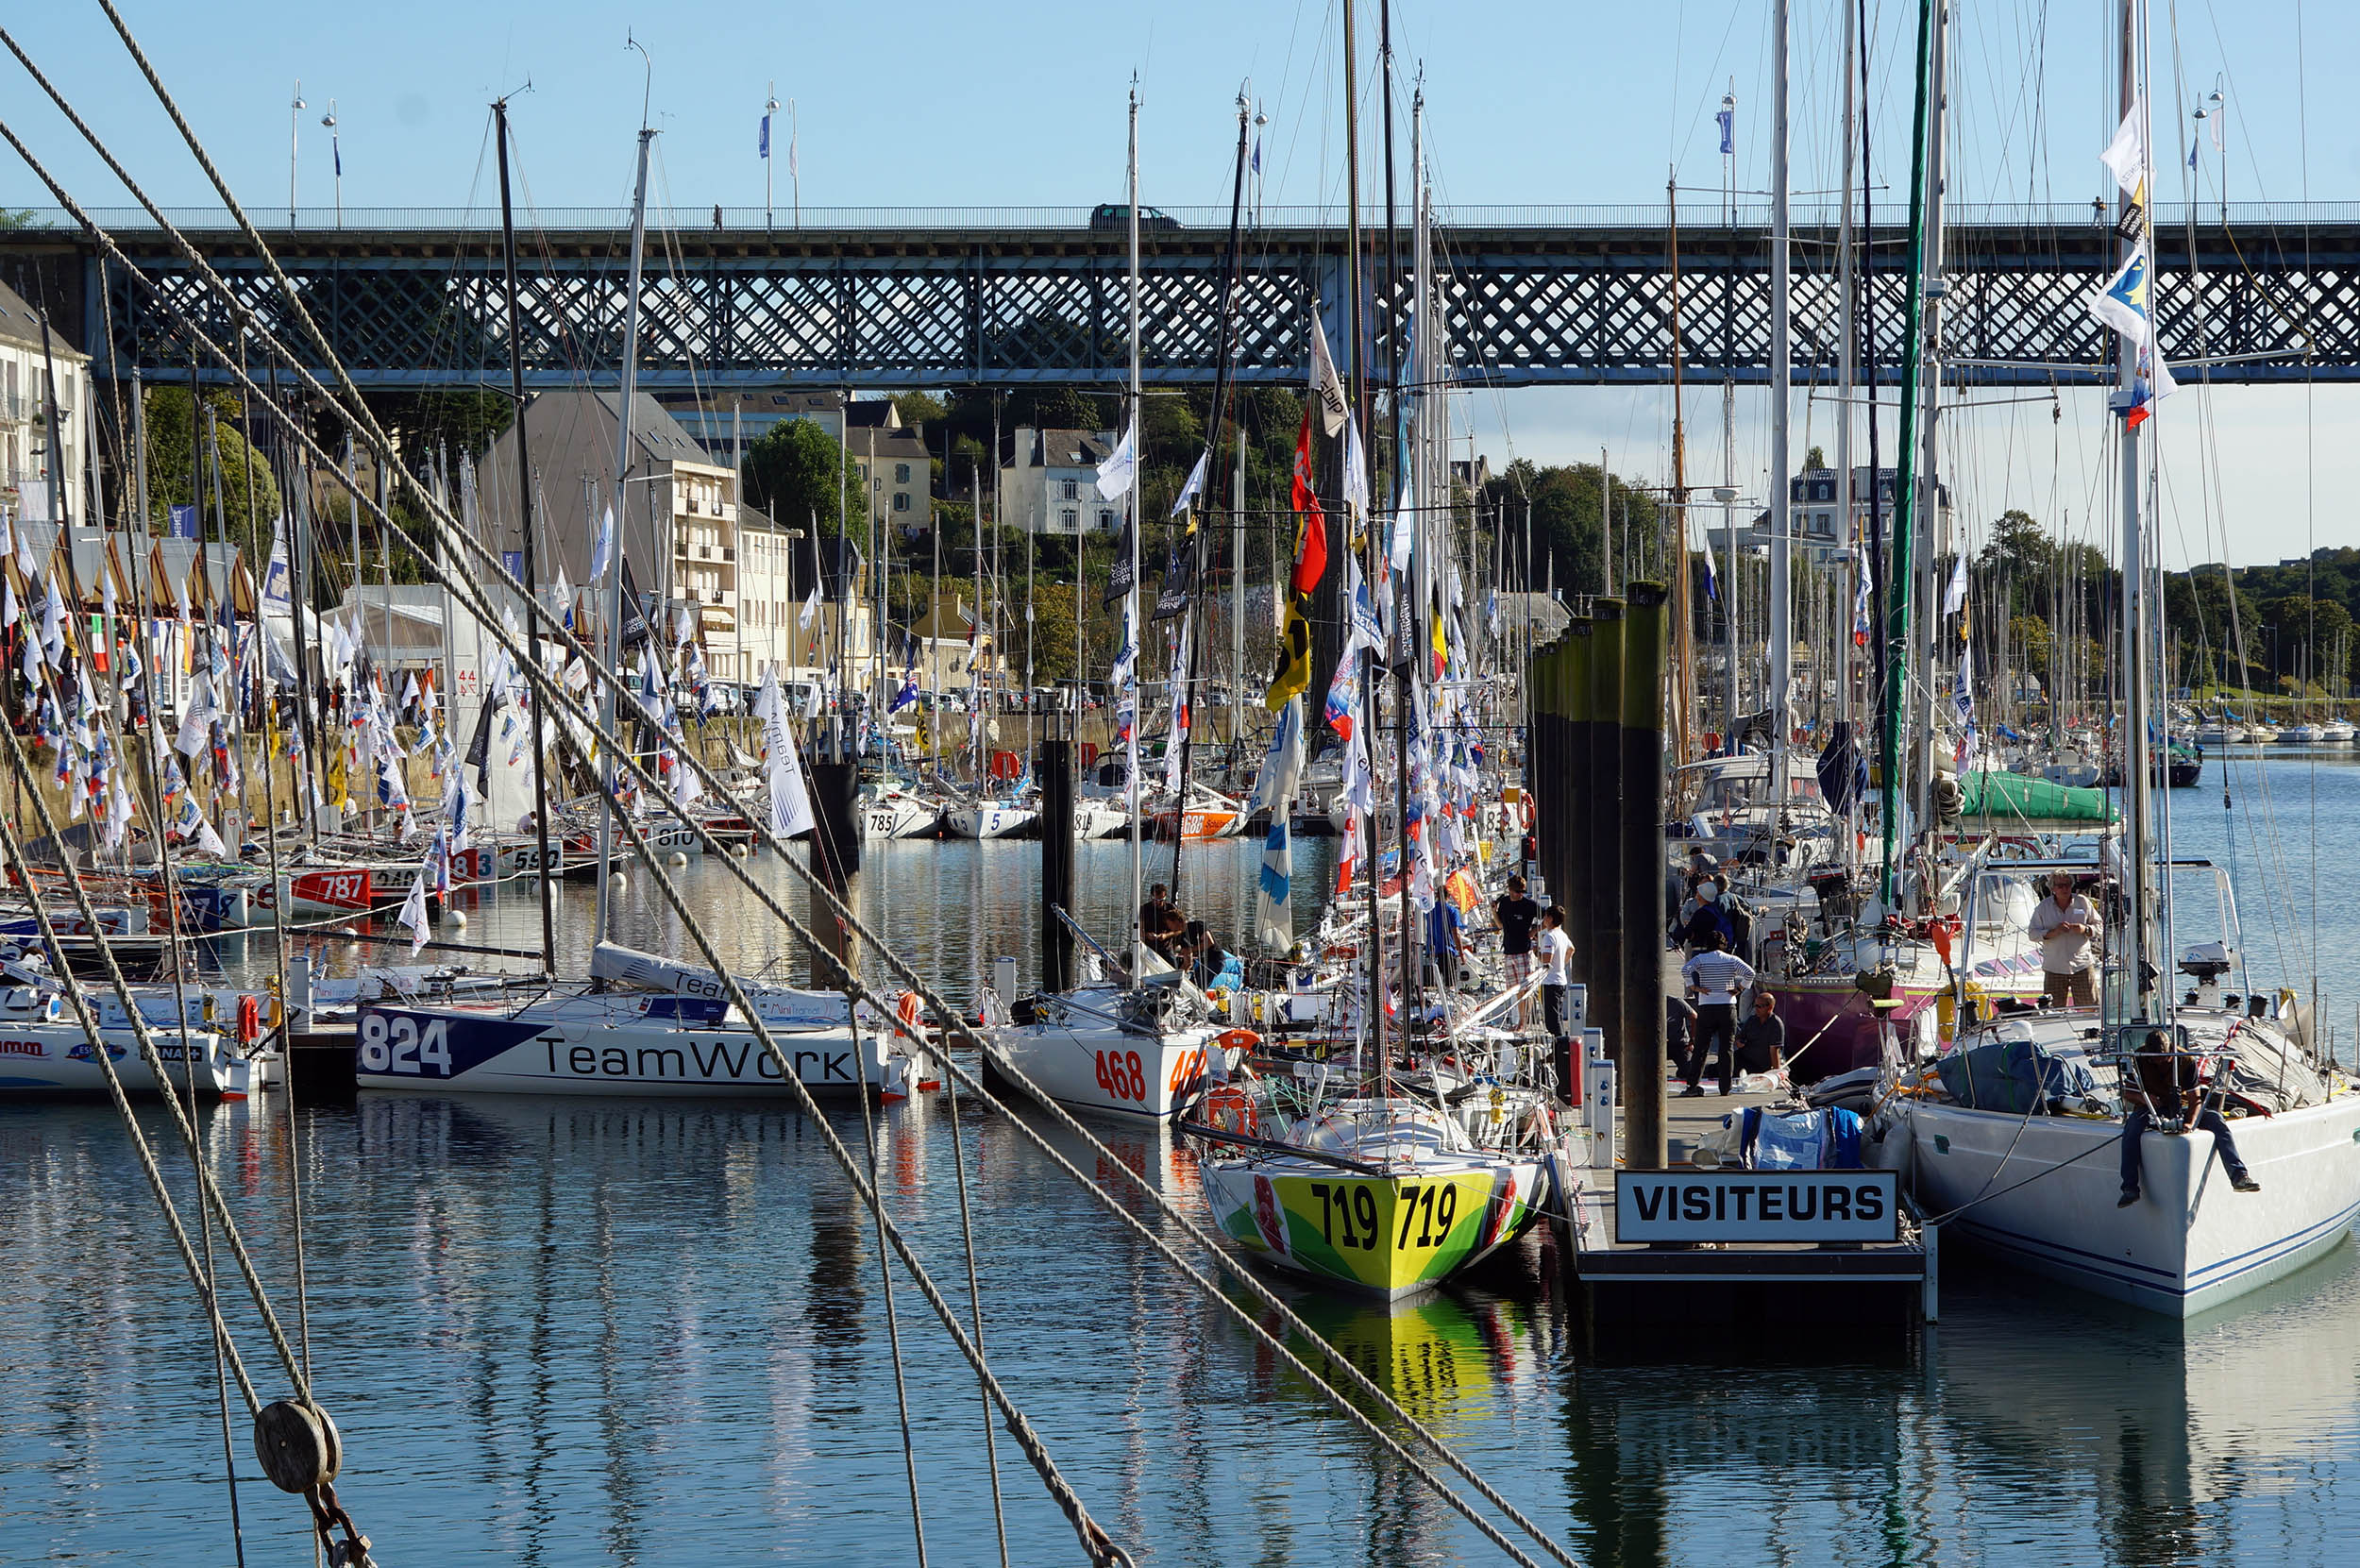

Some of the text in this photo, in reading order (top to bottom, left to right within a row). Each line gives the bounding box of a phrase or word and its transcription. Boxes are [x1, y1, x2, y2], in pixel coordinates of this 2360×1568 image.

[658, 828, 695, 847] 810
[870, 815, 893, 832] 785
[321, 874, 363, 900] 787
[360, 1015, 452, 1076] 824
[535, 1037, 853, 1082] TeamWork
[1095, 1050, 1146, 1102] 468
[1310, 1183, 1378, 1251] 719
[1398, 1182, 1458, 1251] 719
[1632, 1185, 1884, 1222] VISITEURS
